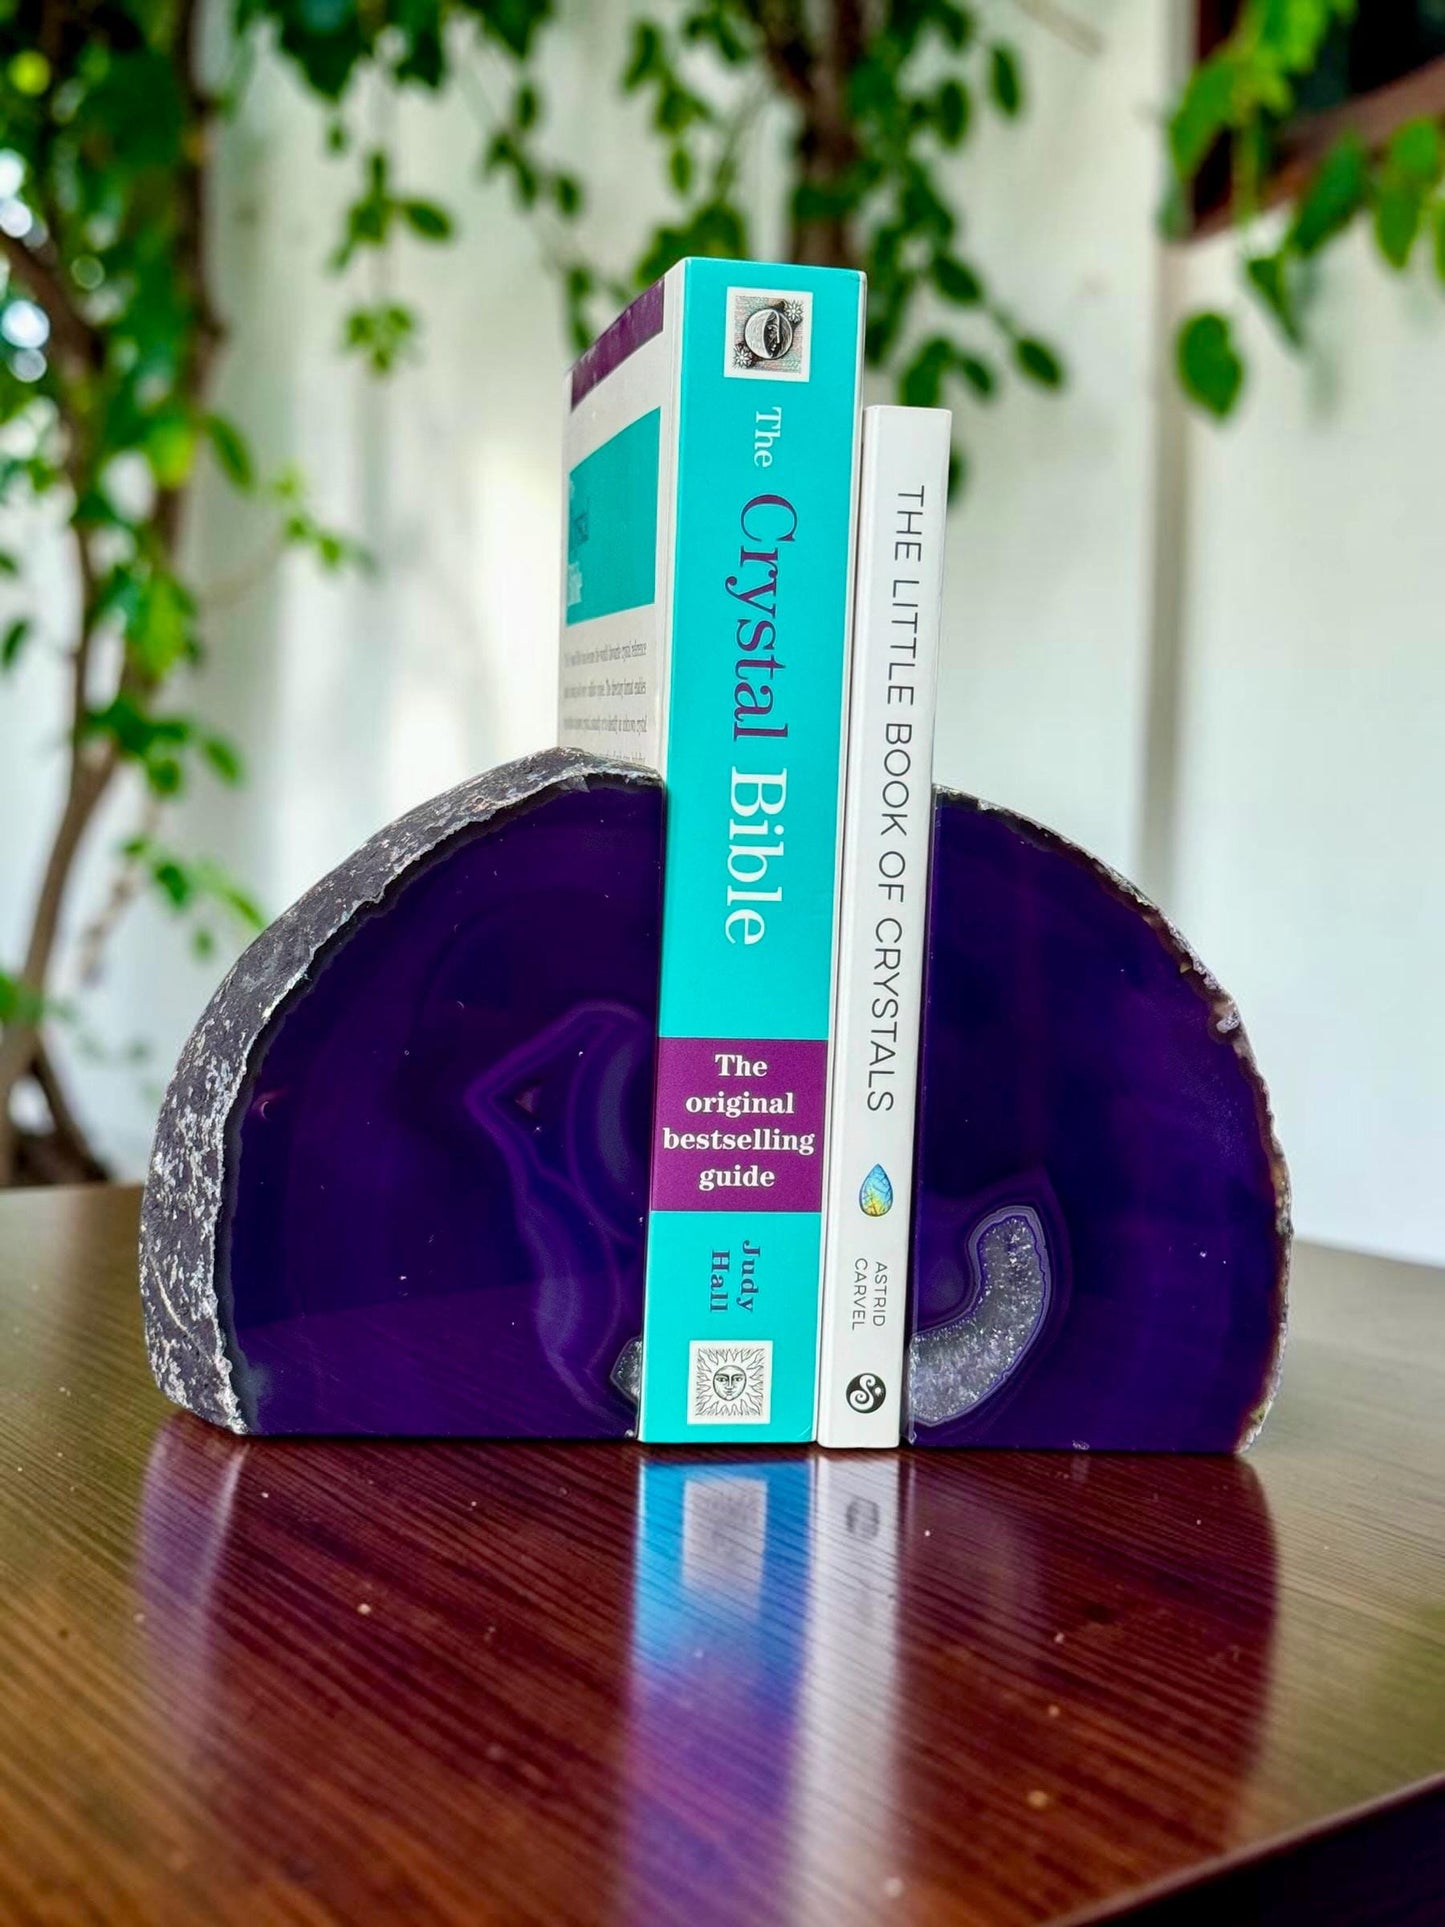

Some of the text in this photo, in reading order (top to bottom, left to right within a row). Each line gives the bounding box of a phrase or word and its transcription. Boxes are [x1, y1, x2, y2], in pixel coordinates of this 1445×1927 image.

[725, 406, 798, 945] The Crystal Bible
[866, 485, 925, 1112] THE LITTLE BOOK OF CRYSTALS
[714, 1053, 768, 1077] The
[685, 1091, 795, 1118] original
[662, 1127, 816, 1156] bestselling
[698, 1164, 776, 1192] guide
[710, 1250, 731, 1312] Hall
[736, 1240, 762, 1312] Judy
[852, 1258, 868, 1331] CARVEL
[872, 1261, 888, 1328] ASTRID
